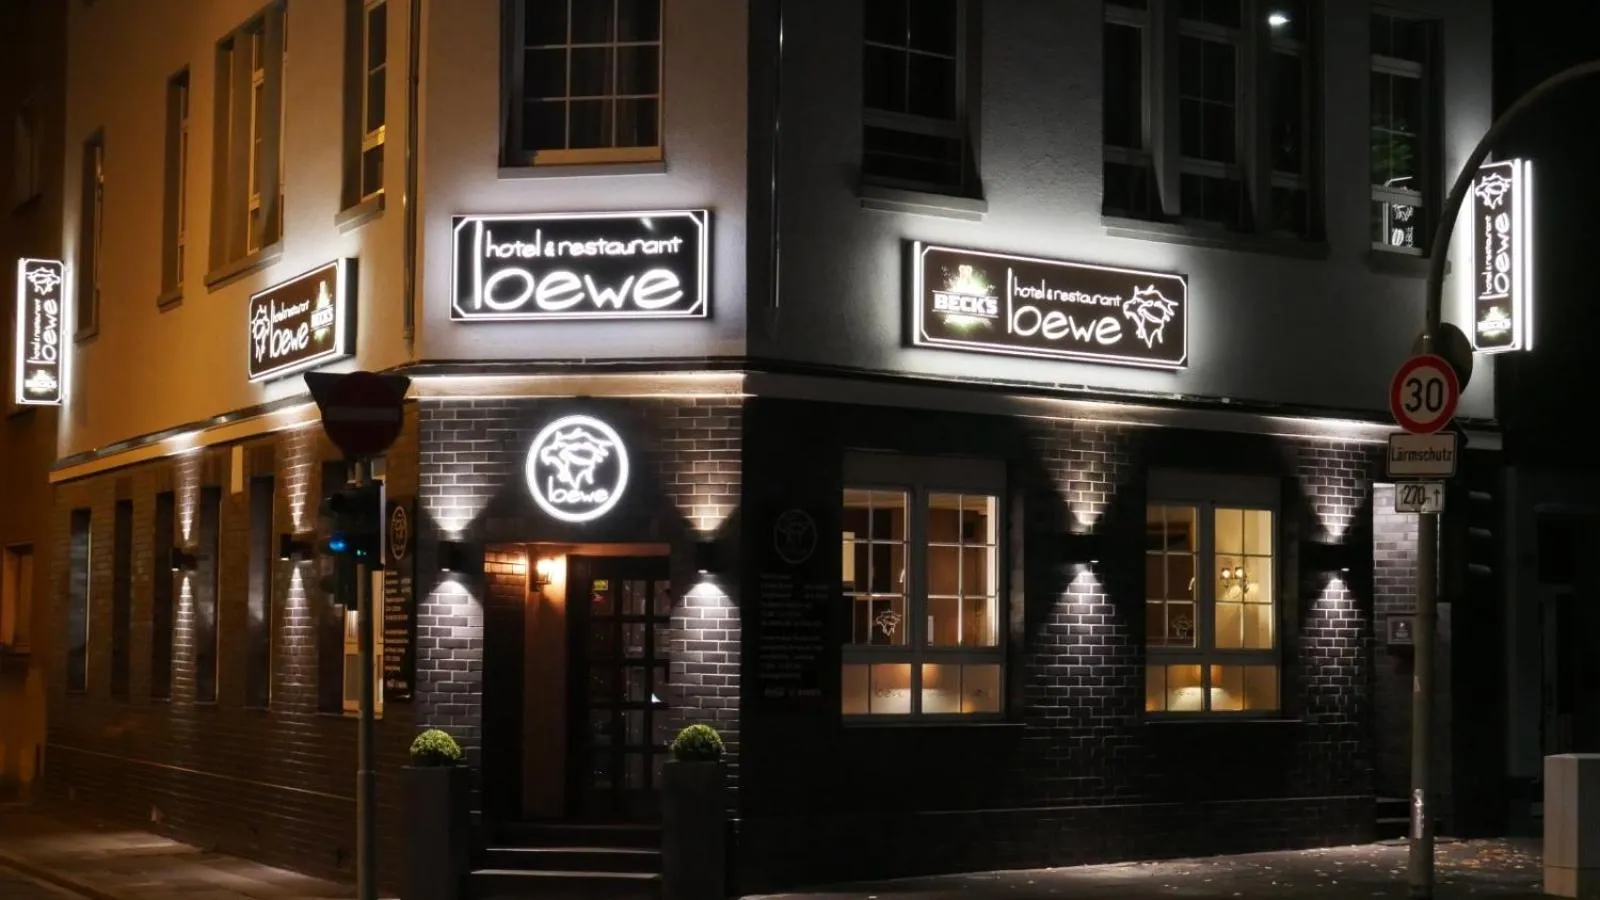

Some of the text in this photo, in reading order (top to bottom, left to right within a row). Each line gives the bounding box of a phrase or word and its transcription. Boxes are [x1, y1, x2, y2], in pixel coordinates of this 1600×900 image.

[474, 219, 684, 311] loewe
[486, 228, 683, 258] hotel & restaurant
[1478, 212, 1511, 300] loewe
[1007, 267, 1123, 345] loewe
[1014, 276, 1045, 300] hotel
[1054, 289, 1122, 307] restaurant
[26, 298, 58, 364] loewe
[269, 298, 310, 359] loewe
[1404, 377, 1444, 413] 30
[1391, 445, 1454, 462] Lärmschutz
[547, 475, 609, 503] loewe
